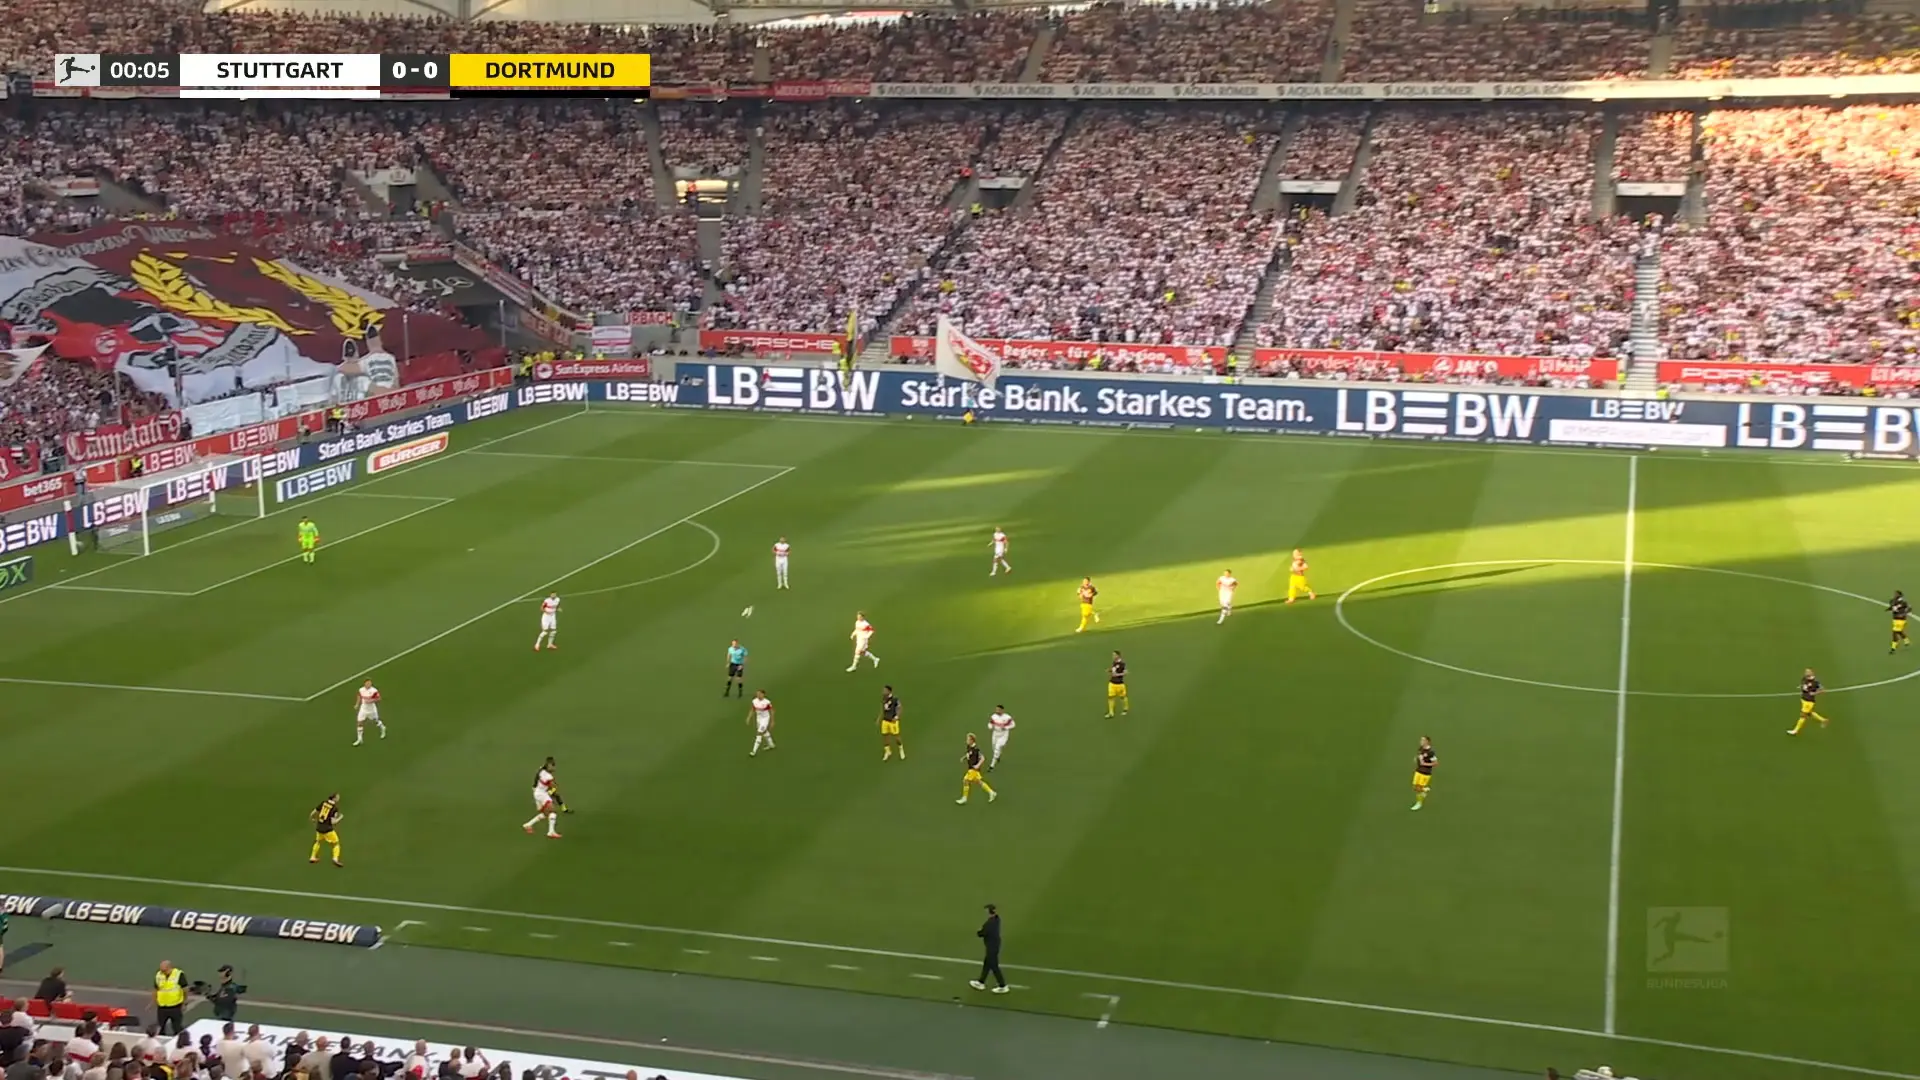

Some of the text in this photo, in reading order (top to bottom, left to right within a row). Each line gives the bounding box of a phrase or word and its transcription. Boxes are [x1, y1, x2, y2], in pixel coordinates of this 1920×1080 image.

[723, 336, 839, 351] PORSCHE
[555, 361, 646, 377] SunExpress Airlines
[1455, 359, 1499, 374] JAKO
[900, 378, 1314, 424] Starke Bank. Starkes Team.
[318, 408, 455, 462] Starke Bank. Starkes Team.
[378, 440, 442, 470] BÜRGER
[22, 476, 63, 498] bet365
